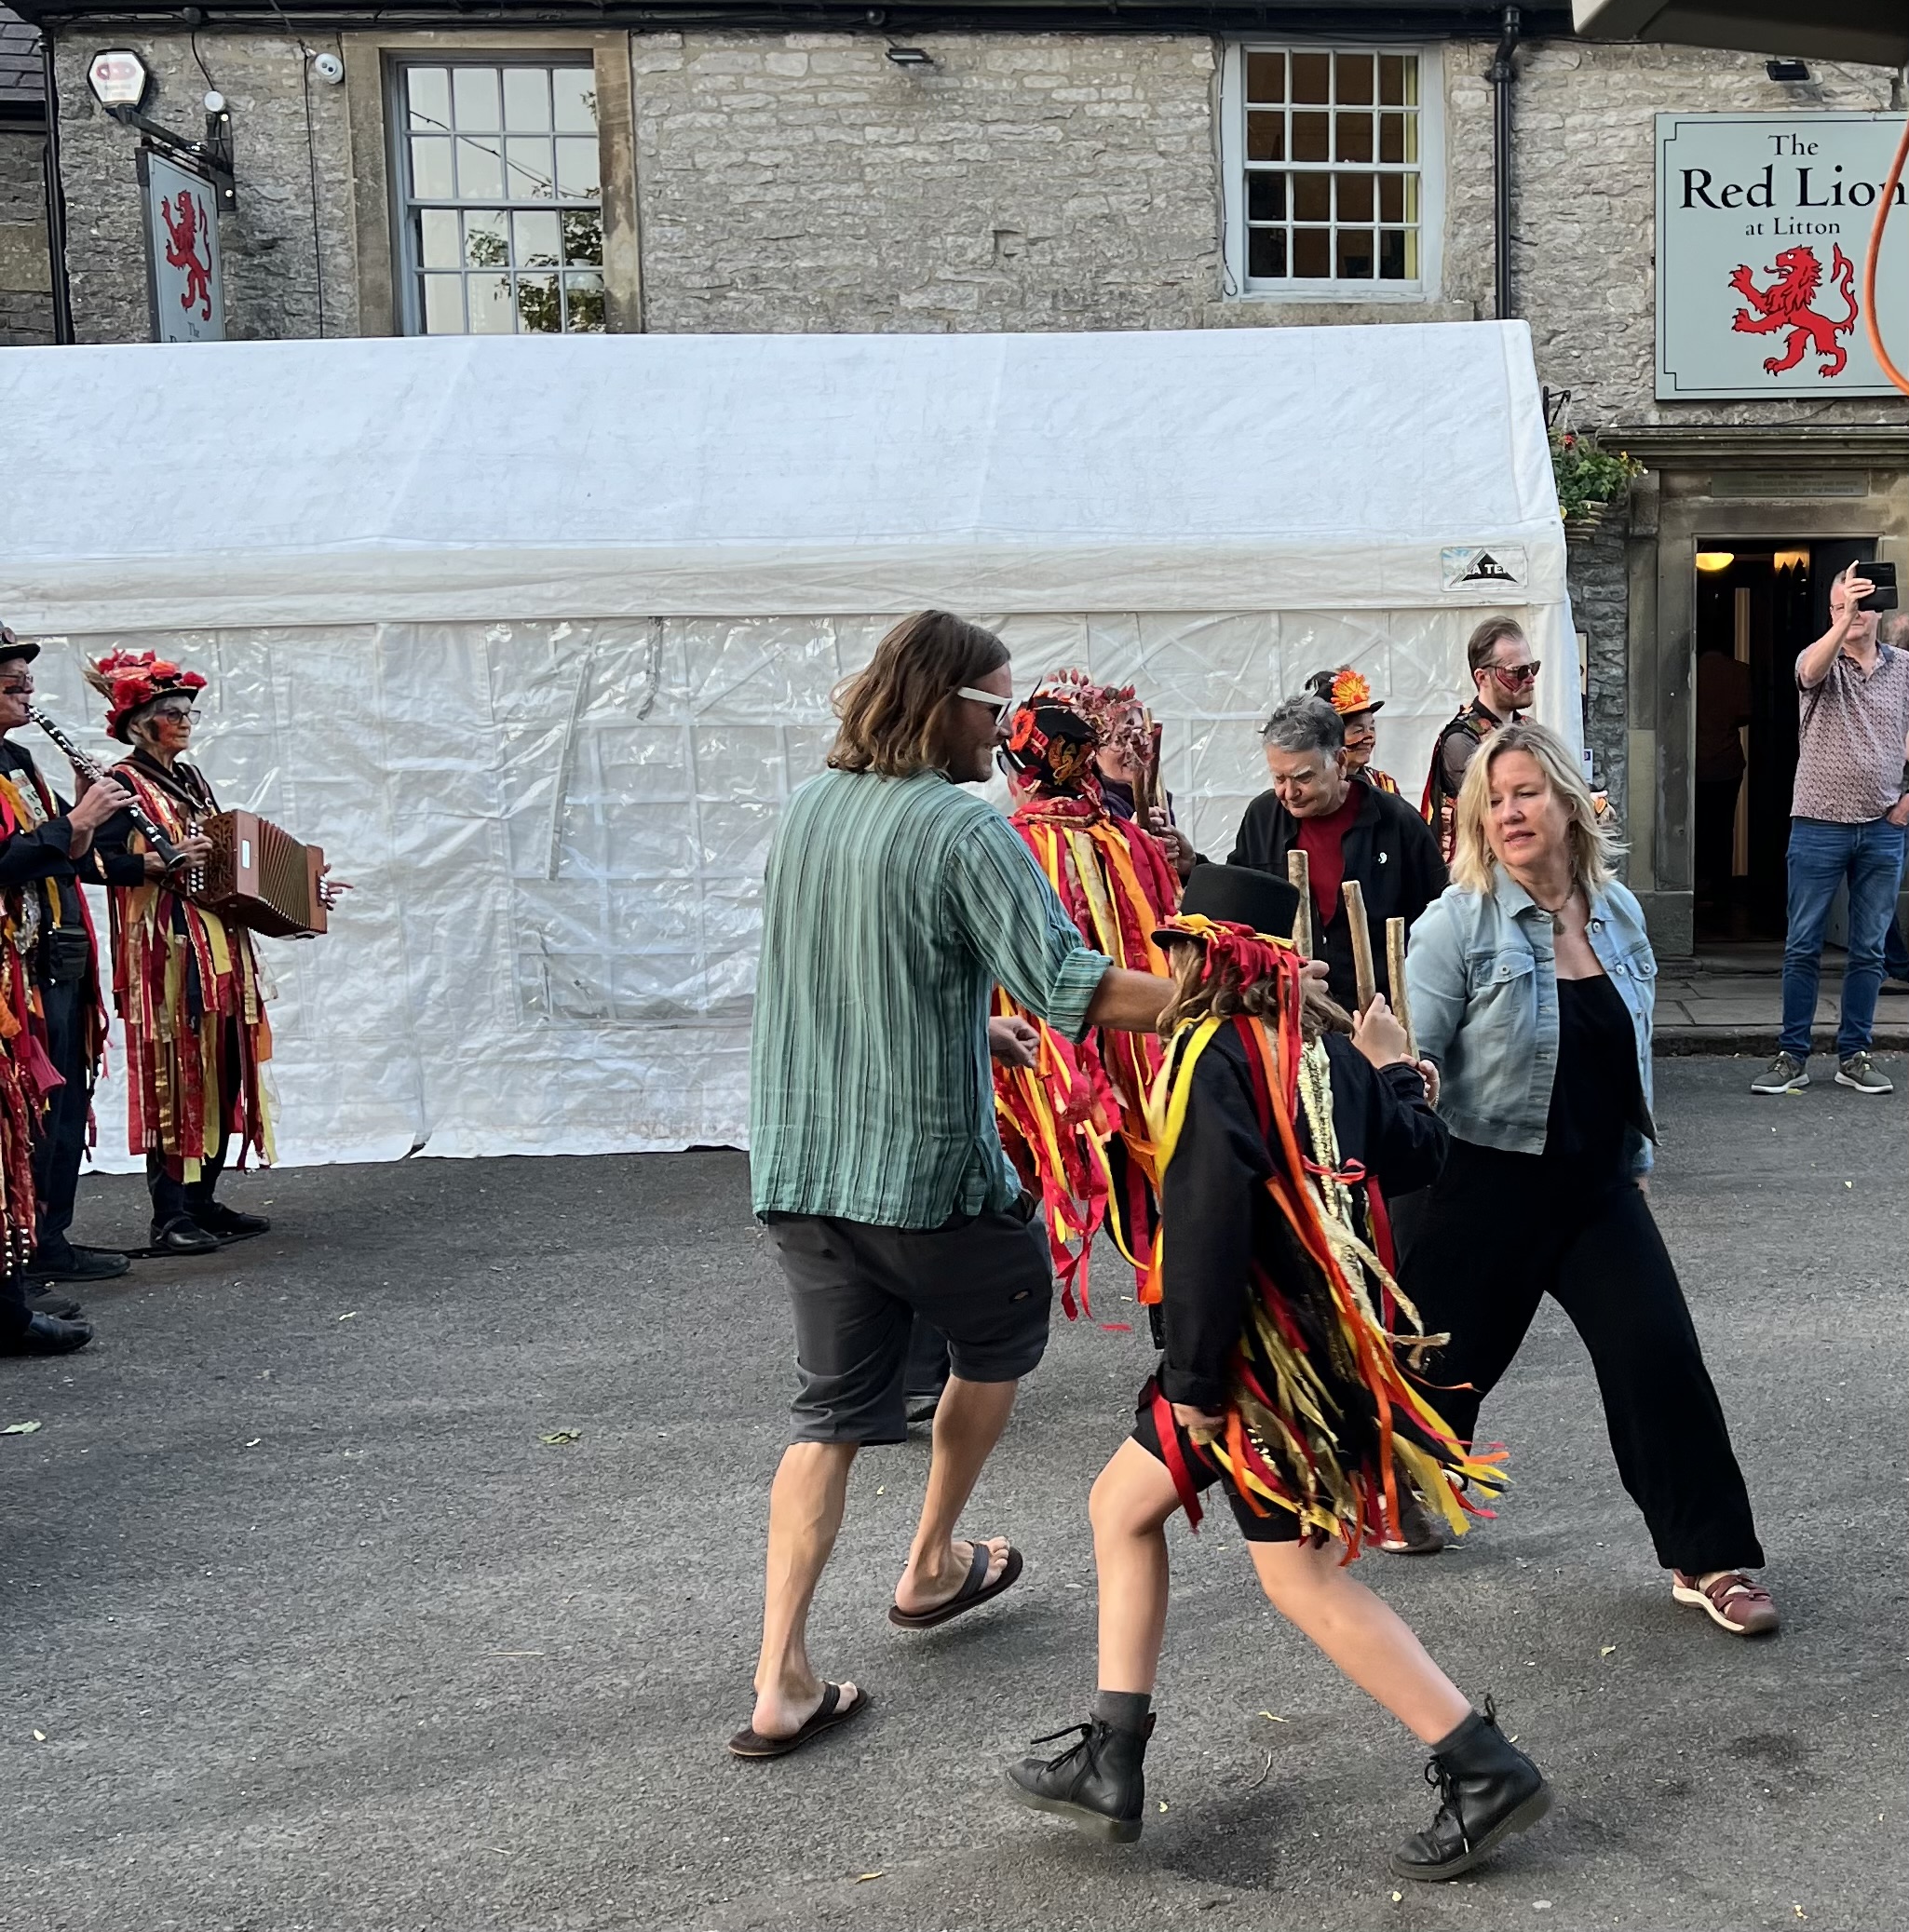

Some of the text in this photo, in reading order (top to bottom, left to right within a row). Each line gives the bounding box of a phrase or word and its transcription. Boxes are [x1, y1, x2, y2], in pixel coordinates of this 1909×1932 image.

[1768, 133, 1819, 156] The
[1679, 164, 1908, 209] Red Lion
[1745, 216, 1840, 236] at Litton
[187, 321, 200, 338] The
